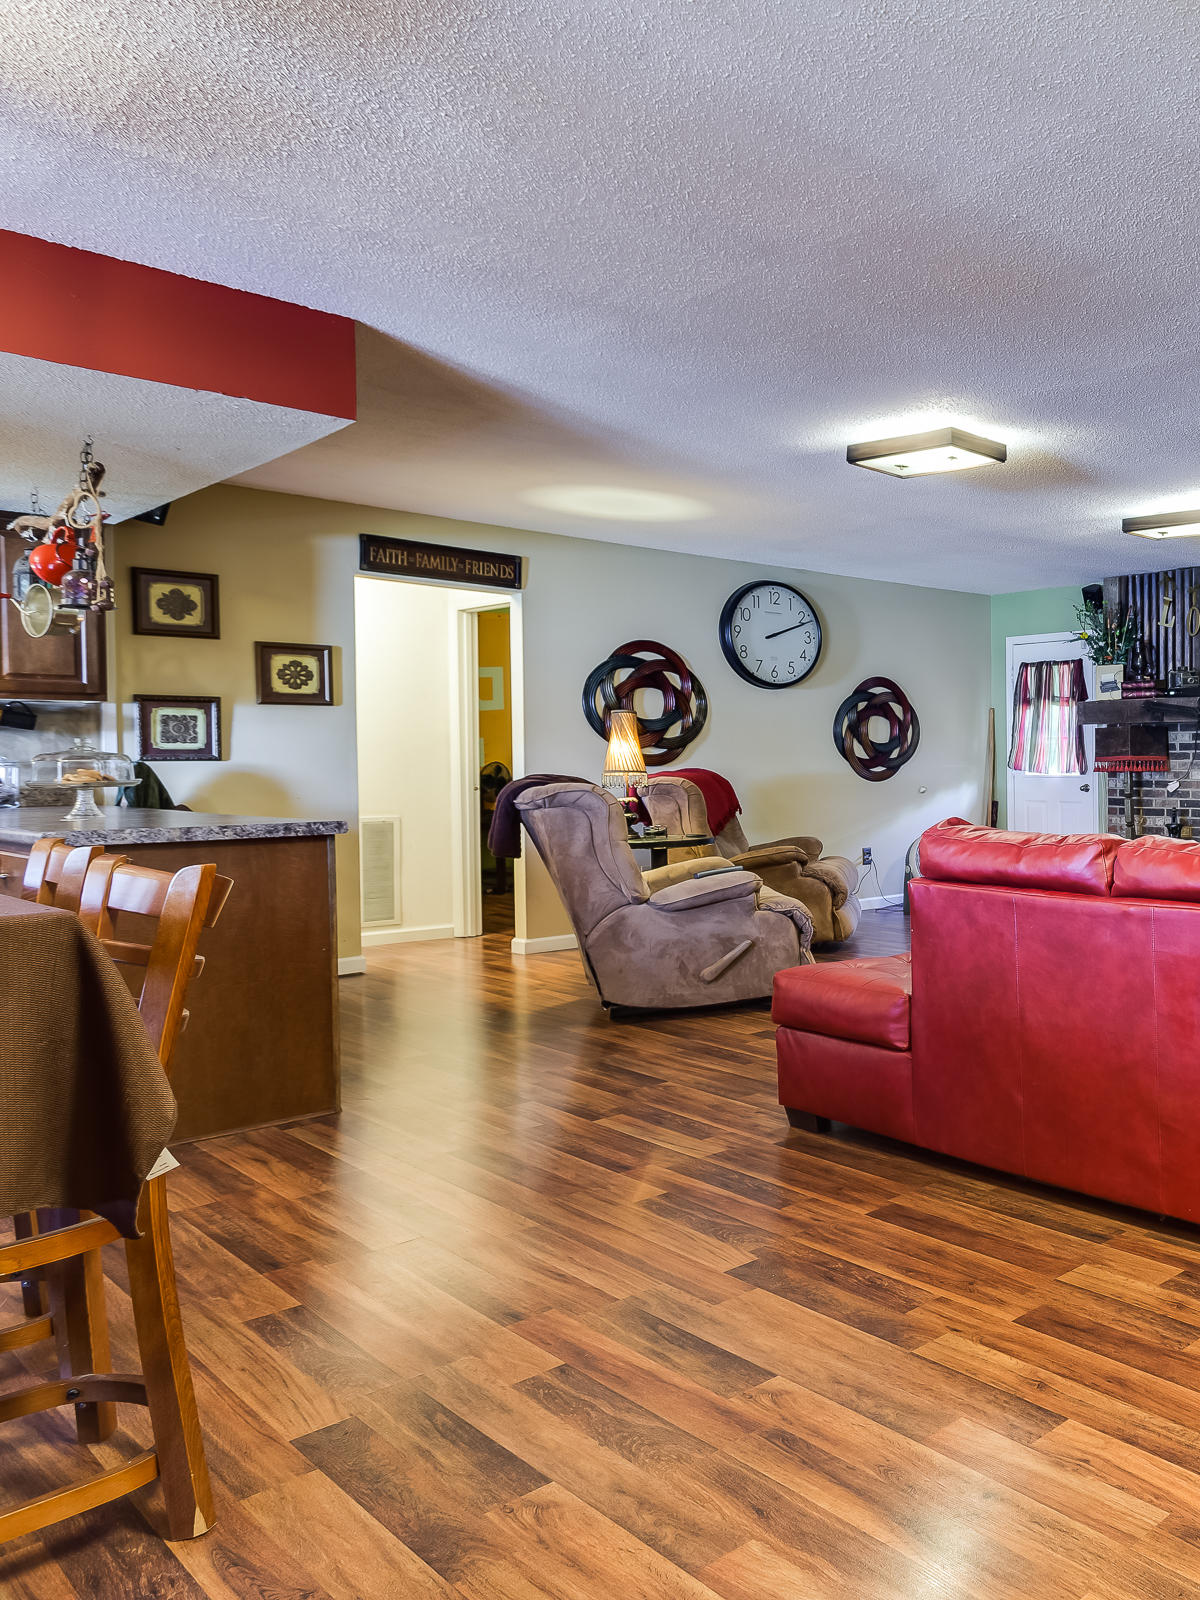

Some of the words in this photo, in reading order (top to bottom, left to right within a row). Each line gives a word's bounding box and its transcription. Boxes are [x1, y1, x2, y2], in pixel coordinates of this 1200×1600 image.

[369, 546, 408, 567] FAITH
[415, 552, 459, 573] FAMILY
[465, 559, 515, 580] FRIENDS
[752, 595, 760, 608] 11
[769, 591, 780, 605] 12
[740, 607, 751, 621] 10
[798, 611, 806, 623] 2
[734, 625, 741, 638] 9
[804, 631, 811, 644] 3
[740, 645, 748, 658] 8
[800, 649, 807, 661] 4
[756, 660, 763, 672] 7
[771, 665, 778, 678] 6
[788, 661, 795, 674] 5
